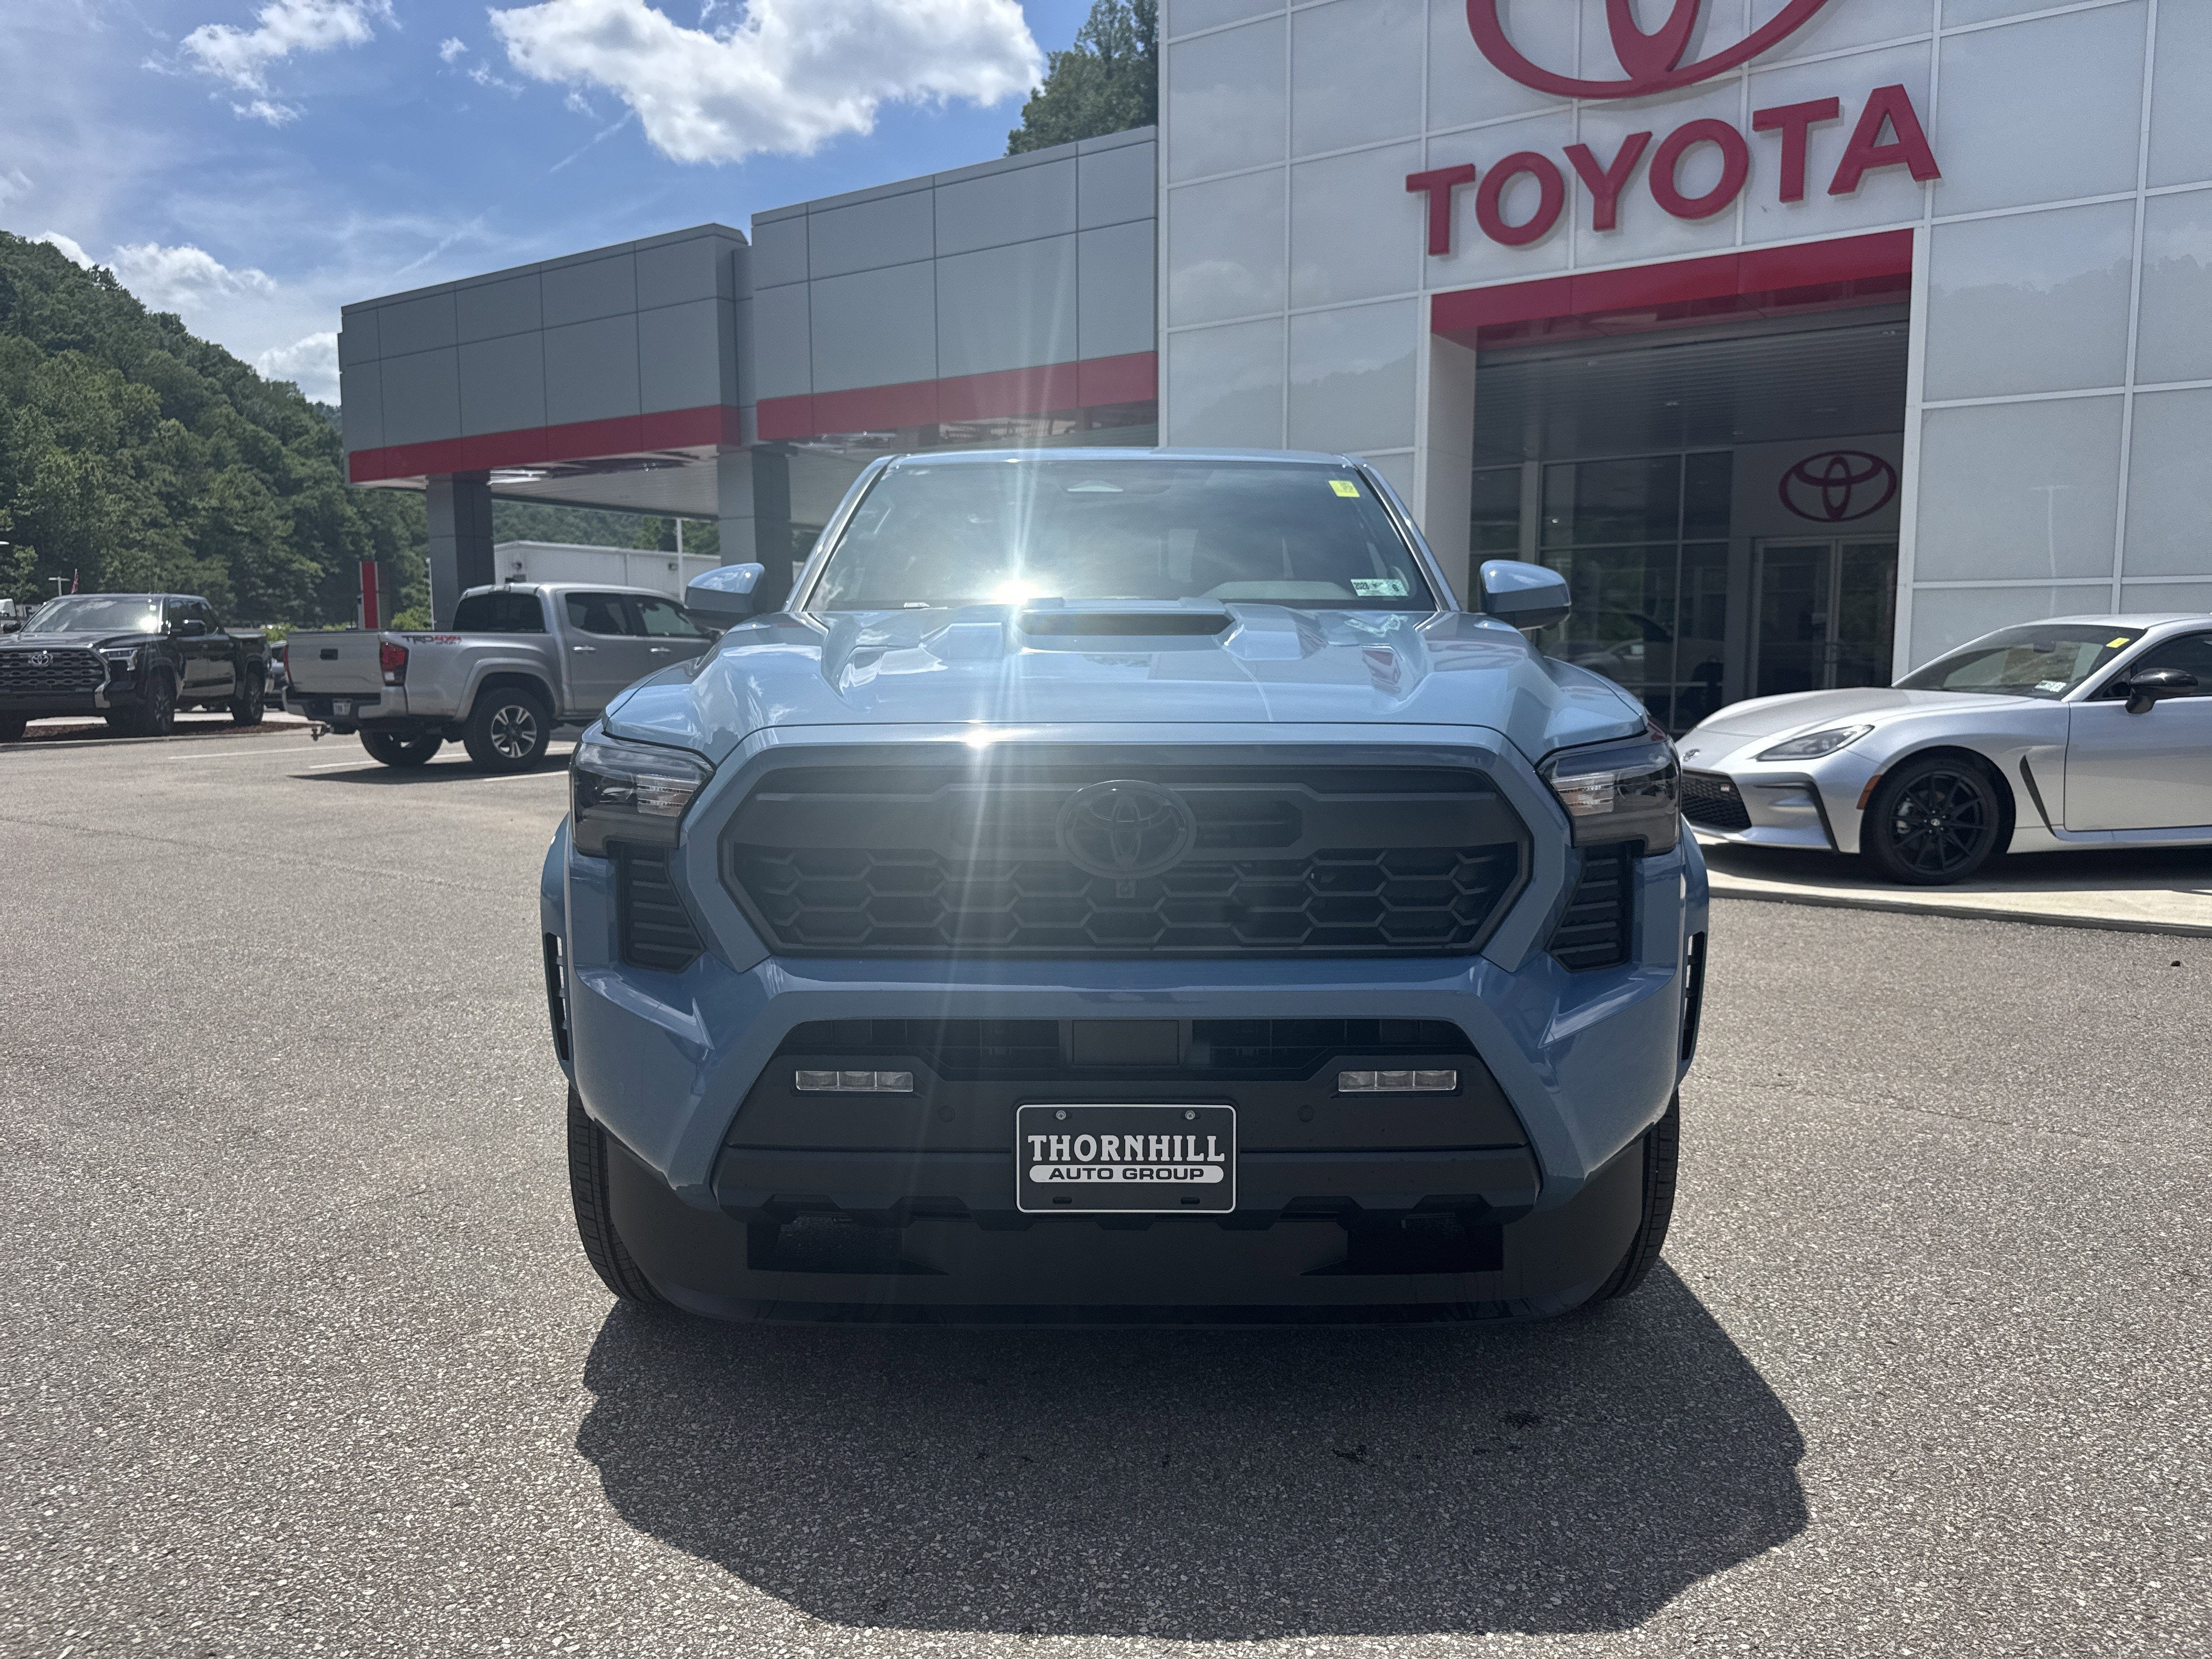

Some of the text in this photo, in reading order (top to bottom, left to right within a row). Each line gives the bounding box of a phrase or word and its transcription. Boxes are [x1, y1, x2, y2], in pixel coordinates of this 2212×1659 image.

[1406, 84, 1942, 255] TOYOTA
[402, 635, 434, 644] TRD
[1028, 1134, 1225, 1162] THORNHILL
[1048, 1167, 1205, 1181] AUTO GROUP
